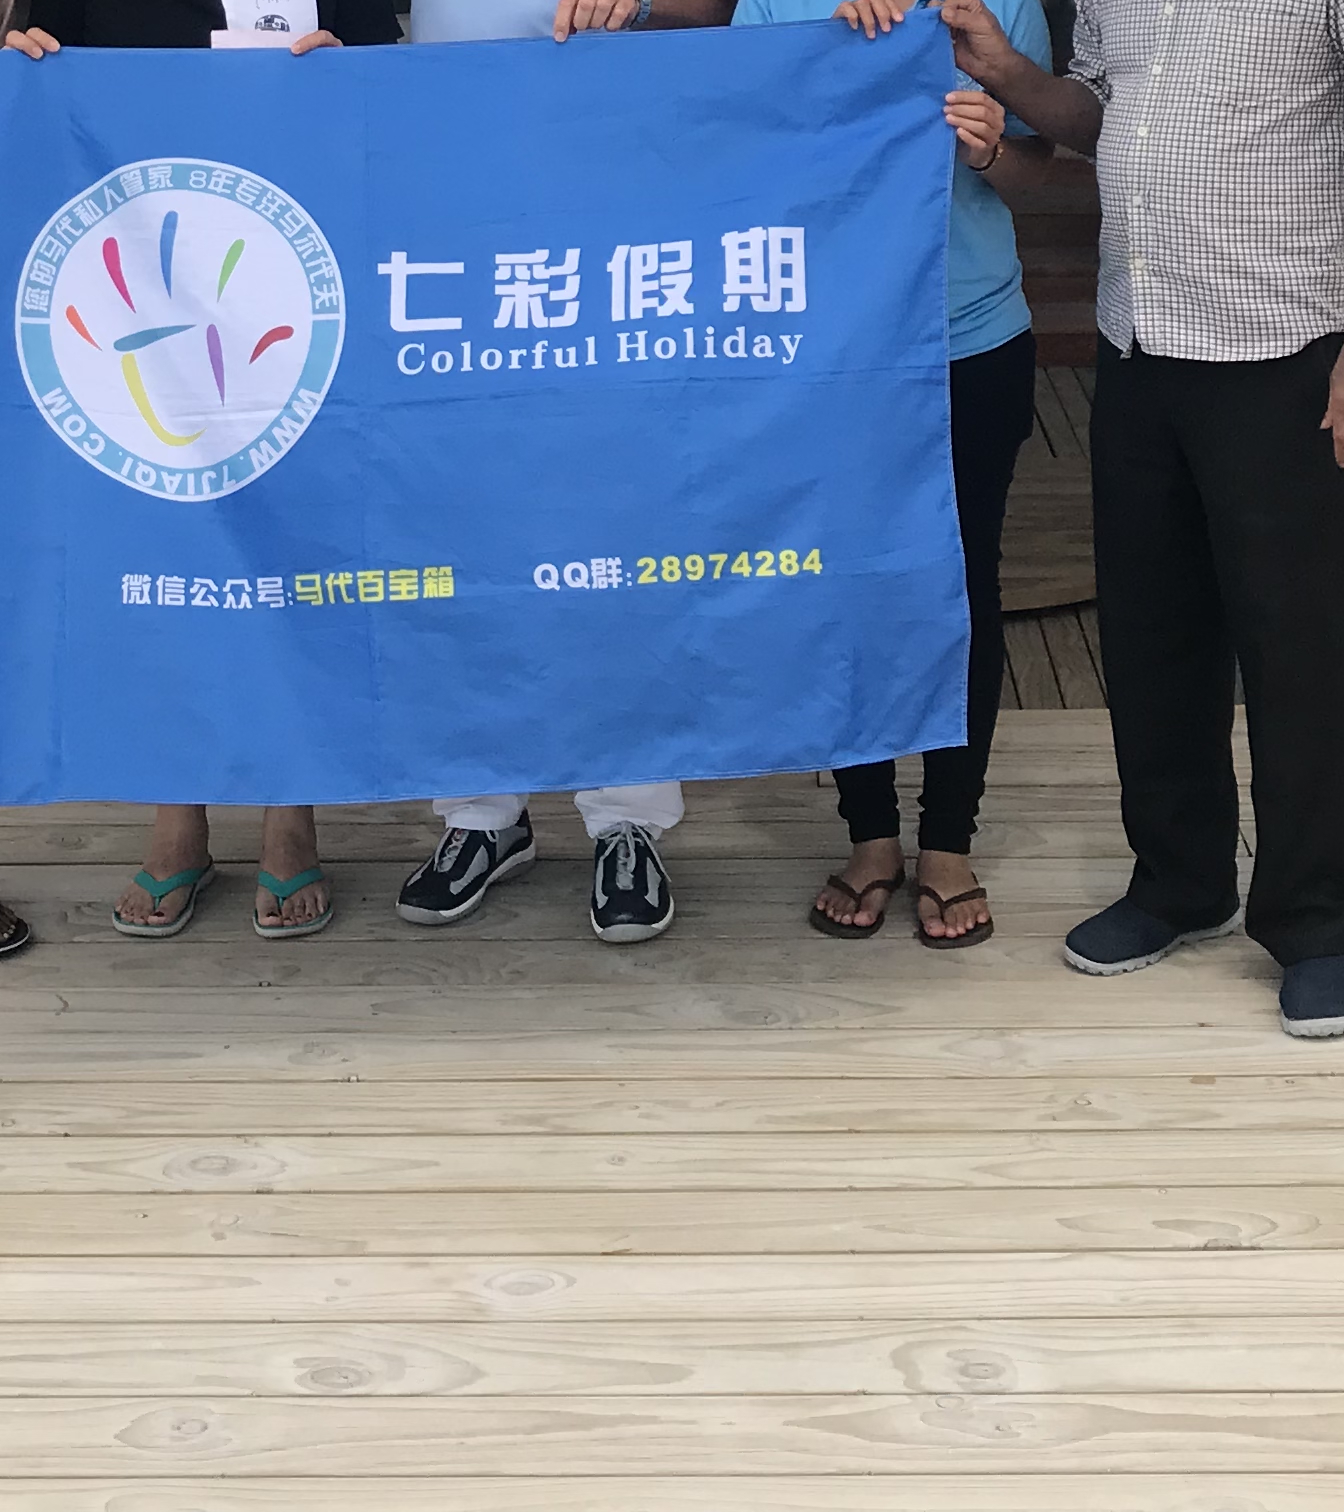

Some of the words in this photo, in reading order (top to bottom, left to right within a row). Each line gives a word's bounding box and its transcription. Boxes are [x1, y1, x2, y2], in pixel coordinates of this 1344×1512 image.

[377, 226, 807, 333] 七彩假期
[396, 335, 598, 376] Colorful
[616, 326, 803, 365] Holiday
